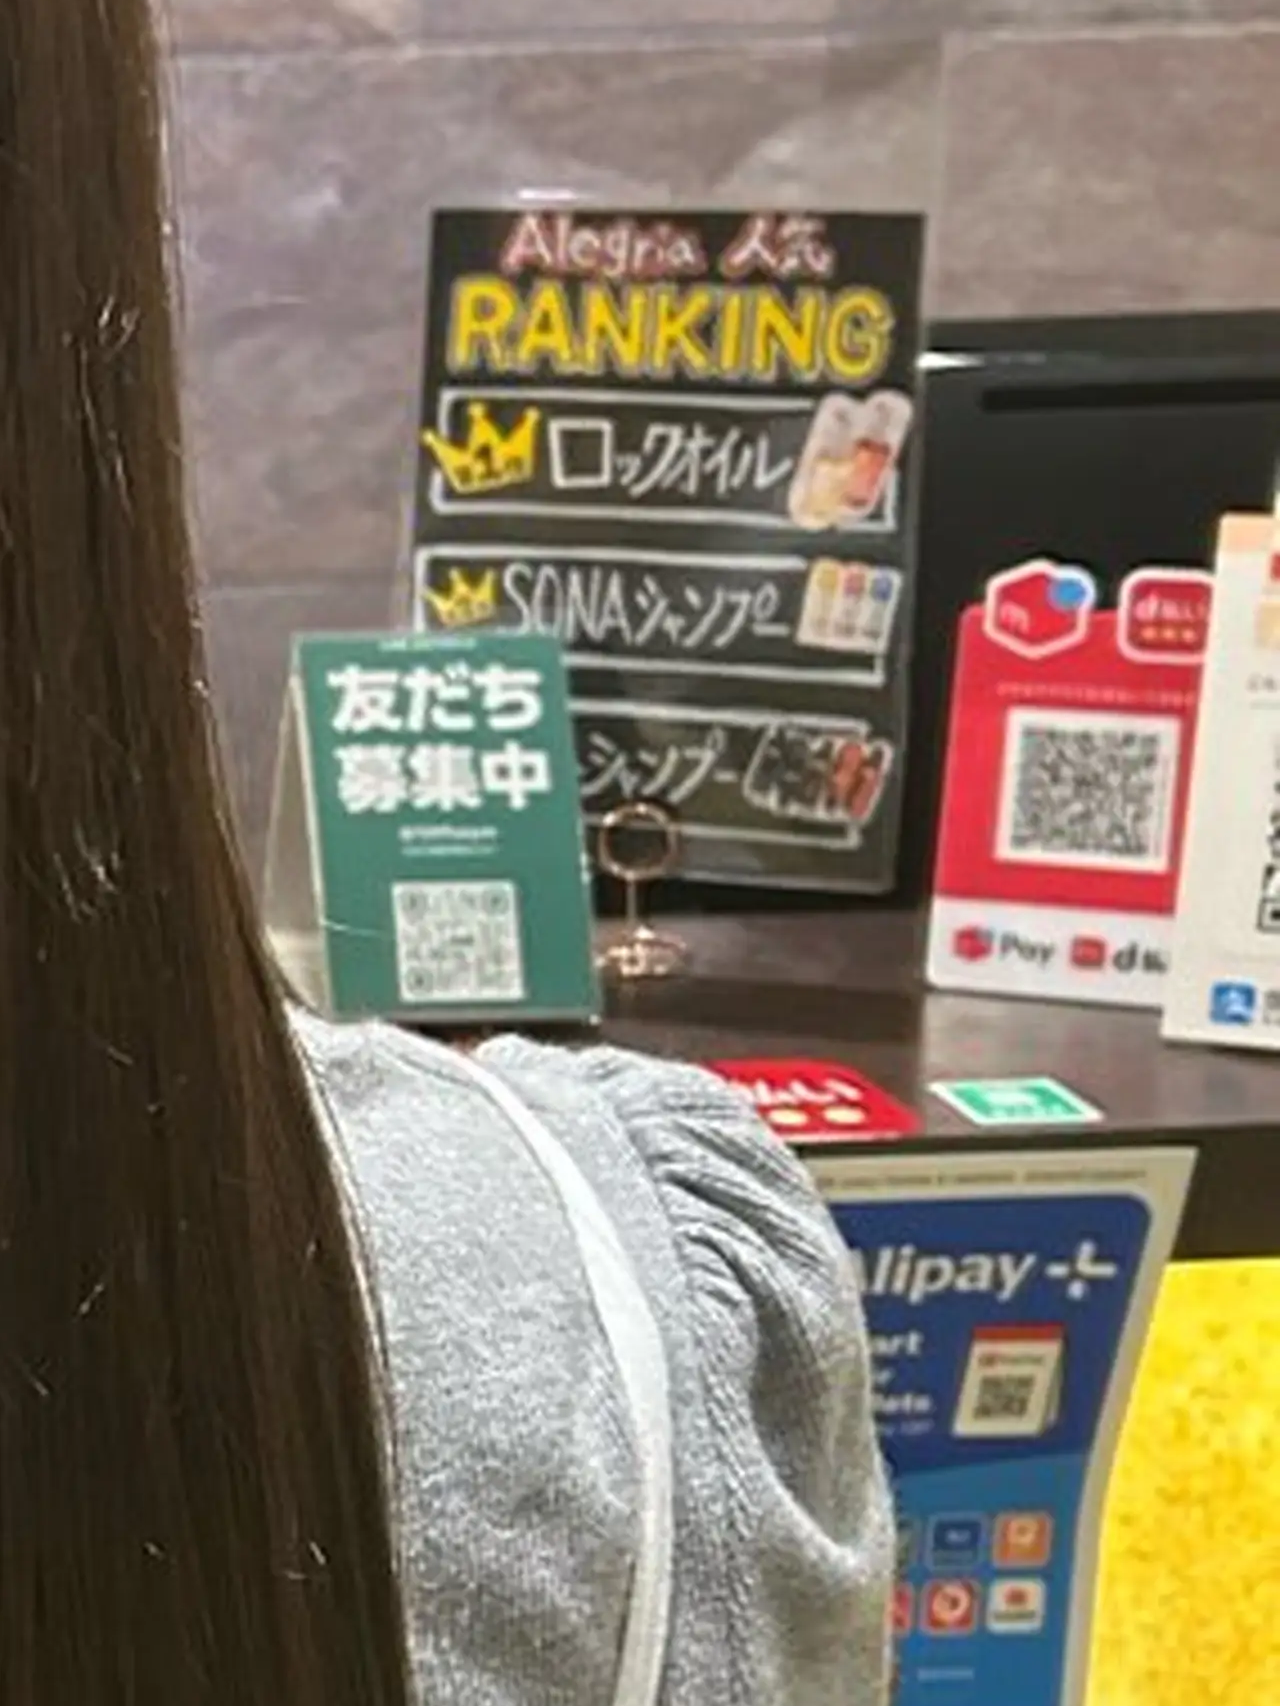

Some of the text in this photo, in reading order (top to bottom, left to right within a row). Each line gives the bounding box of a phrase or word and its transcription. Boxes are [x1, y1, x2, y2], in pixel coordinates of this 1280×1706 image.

[500, 213, 835, 277] Alegria 人気
[448, 277, 894, 381] RANKING
[548, 417, 794, 499] ロックオイル
[326, 662, 544, 731] 友だち
[332, 740, 552, 813] 募集中
[999, 931, 1056, 967] Pay
